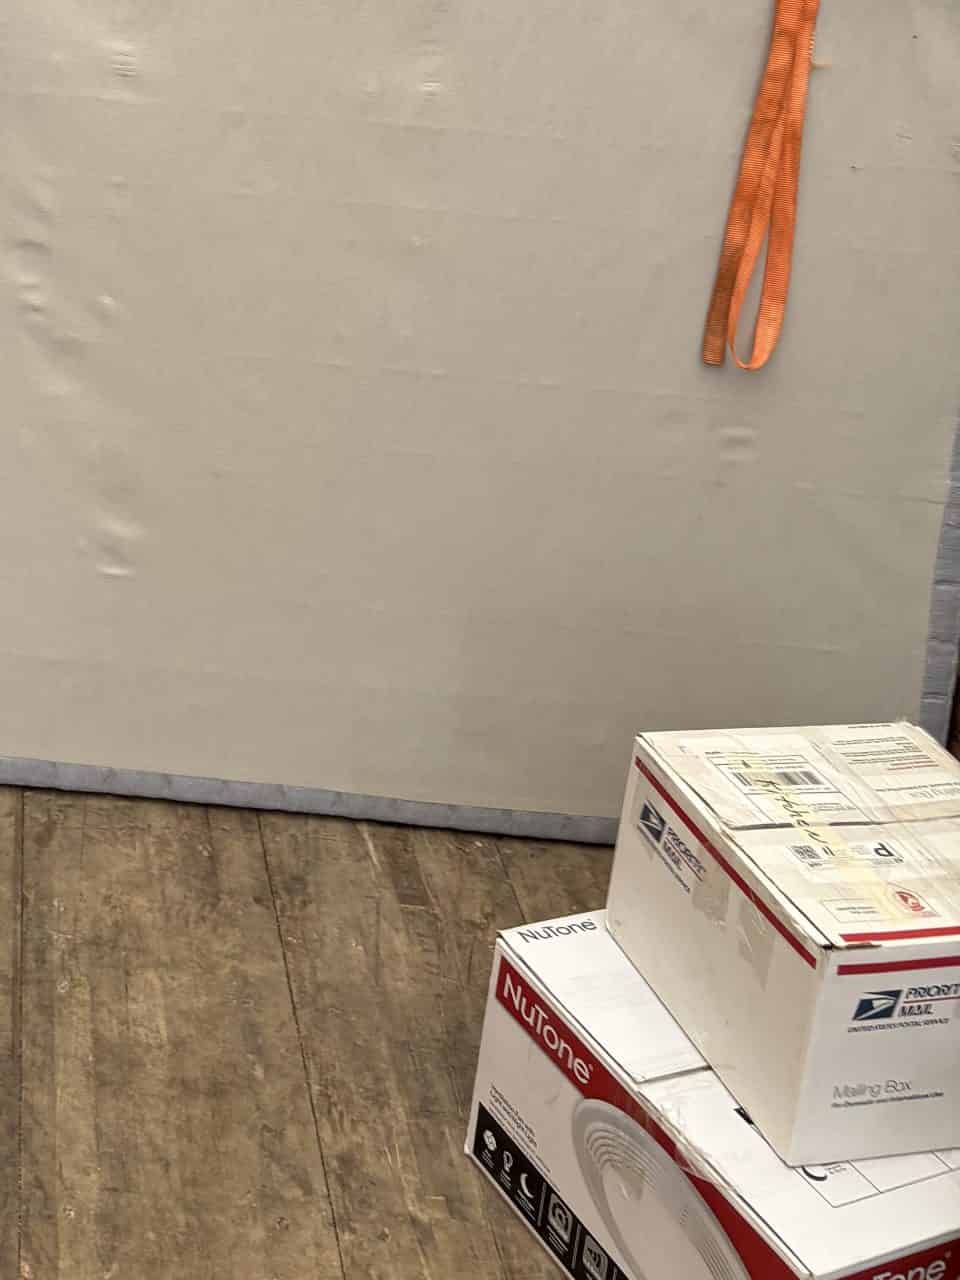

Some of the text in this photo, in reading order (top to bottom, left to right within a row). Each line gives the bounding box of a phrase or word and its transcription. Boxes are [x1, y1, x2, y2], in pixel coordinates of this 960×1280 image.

[517, 918, 598, 943] NuTone
[503, 972, 590, 1085] NuTone
[833, 1083, 881, 1100] Mailing
[885, 1079, 912, 1094] Box
